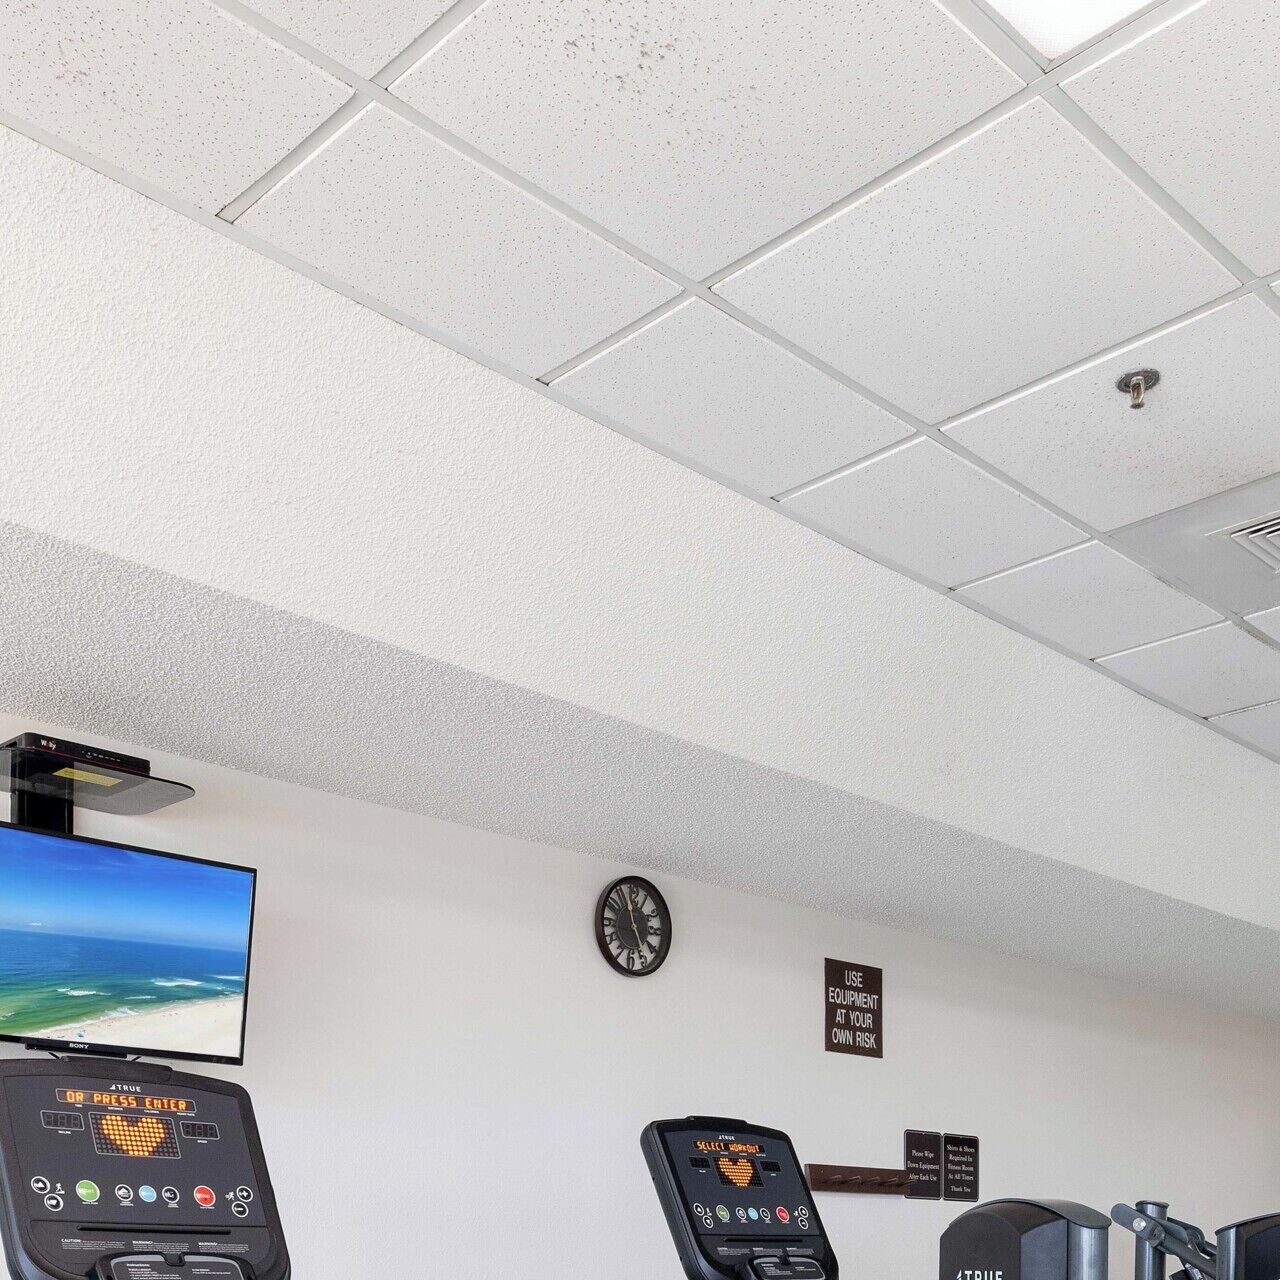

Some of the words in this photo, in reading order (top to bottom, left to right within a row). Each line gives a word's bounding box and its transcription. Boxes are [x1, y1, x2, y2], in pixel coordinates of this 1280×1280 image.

[845, 970, 863, 987] USE
[829, 987, 879, 1009] EQUIPMENT
[836, 1009, 846, 1024] AT
[849, 1010, 873, 1028] YOUR
[832, 1028, 853, 1045] OWN
[856, 1031, 876, 1048] RISK
[117, 1084, 141, 1092] TRUE
[66, 1091, 84, 1102] OR
[93, 1093, 137, 1107] PRESS
[144, 1097, 187, 1111] ENTER
[697, 1141, 725, 1150] SELECT
[729, 1143, 760, 1153] WORKOUT
[912, 1149, 924, 1157] Please
[924, 1150, 934, 1158] Wipe
[949, 1154, 967, 1162] Required
[920, 1162, 939, 1170] Equipment
